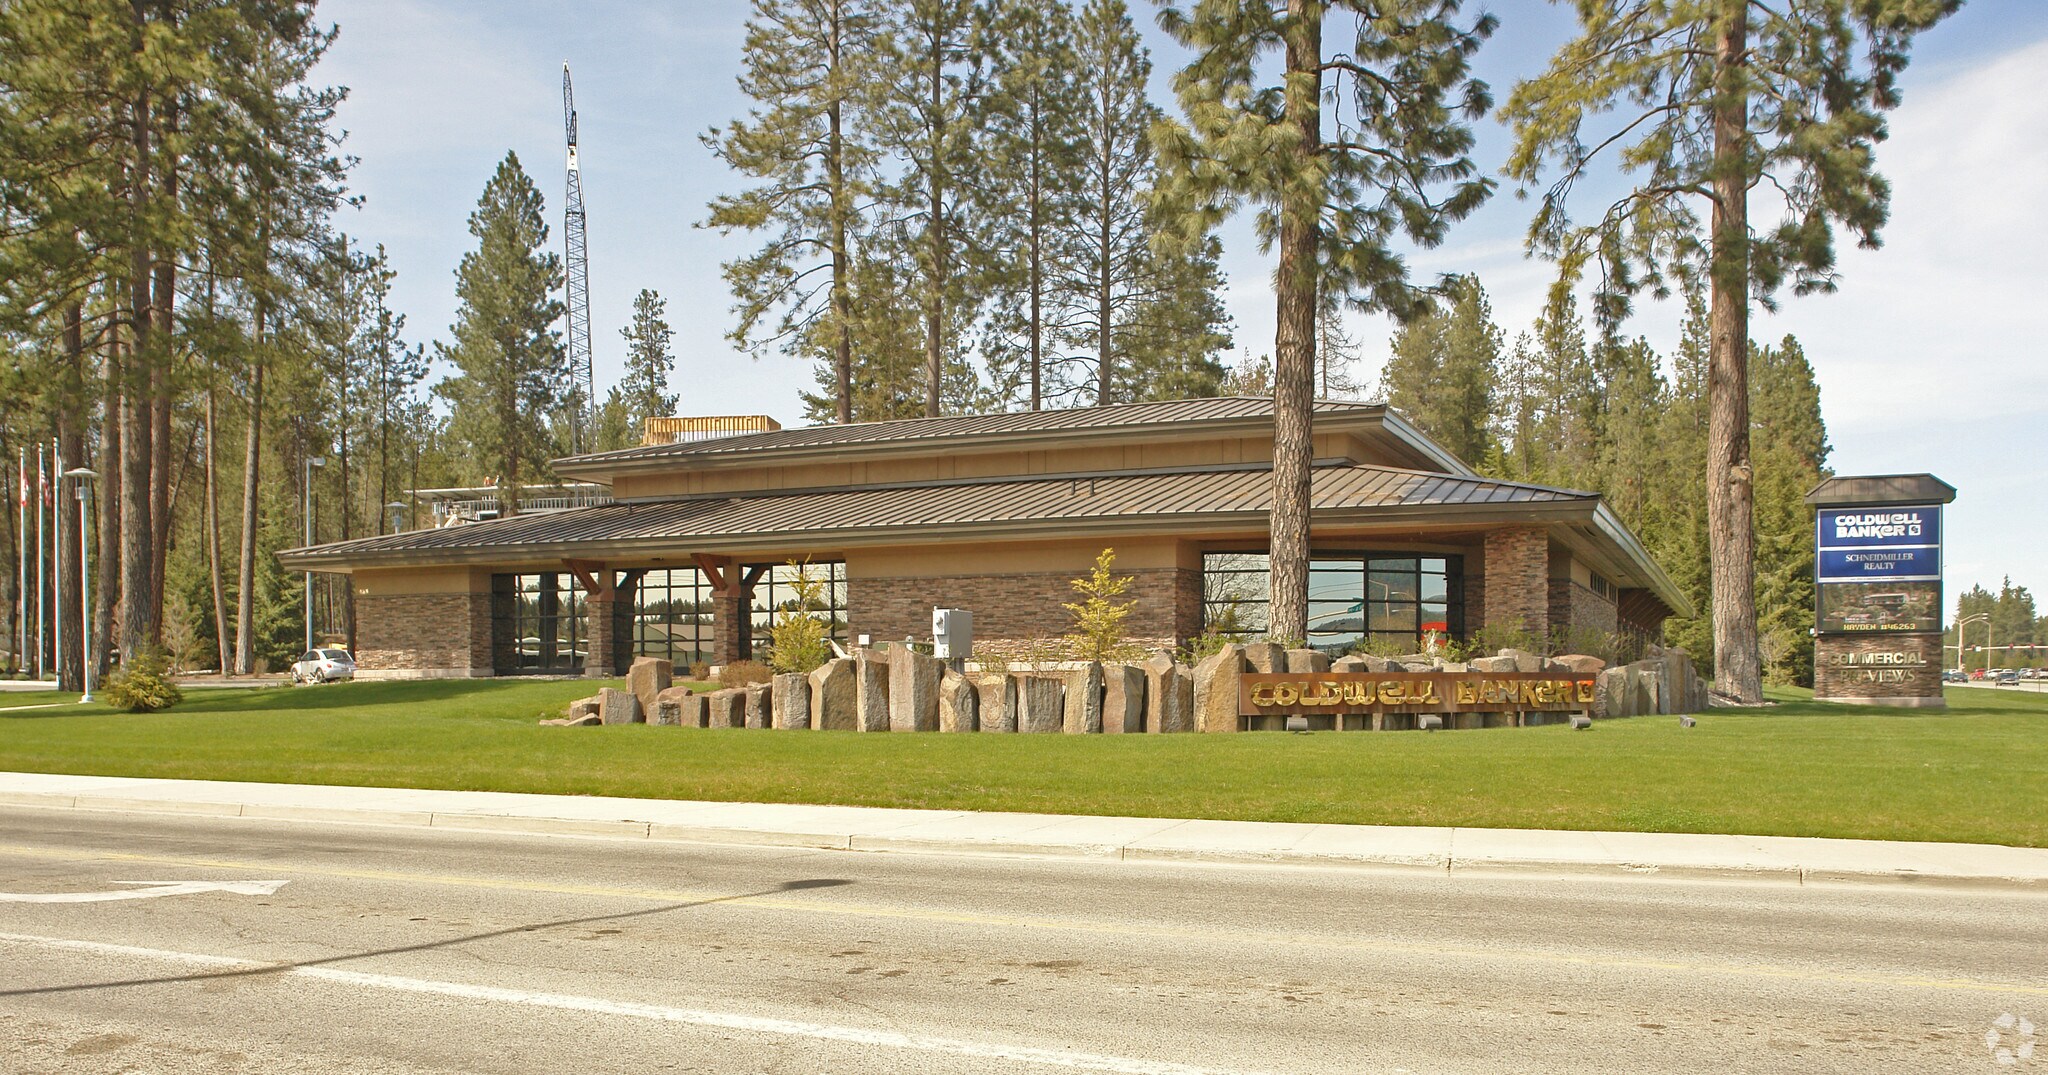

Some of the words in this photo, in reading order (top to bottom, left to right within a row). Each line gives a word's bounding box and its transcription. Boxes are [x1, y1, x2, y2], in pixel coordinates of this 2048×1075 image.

[1835, 513, 1922, 526] COLDWELL
[1836, 525, 1906, 538] BANKER
[1845, 552, 1914, 562] SCHNEIDMILLER
[1864, 562, 1895, 570] REALTY
[1829, 652, 1927, 664] COMMERCIAL
[1840, 669, 1916, 682] PREVIEWS
[1250, 680, 1440, 706] COLDWELL
[1456, 679, 1574, 708] BANKER
